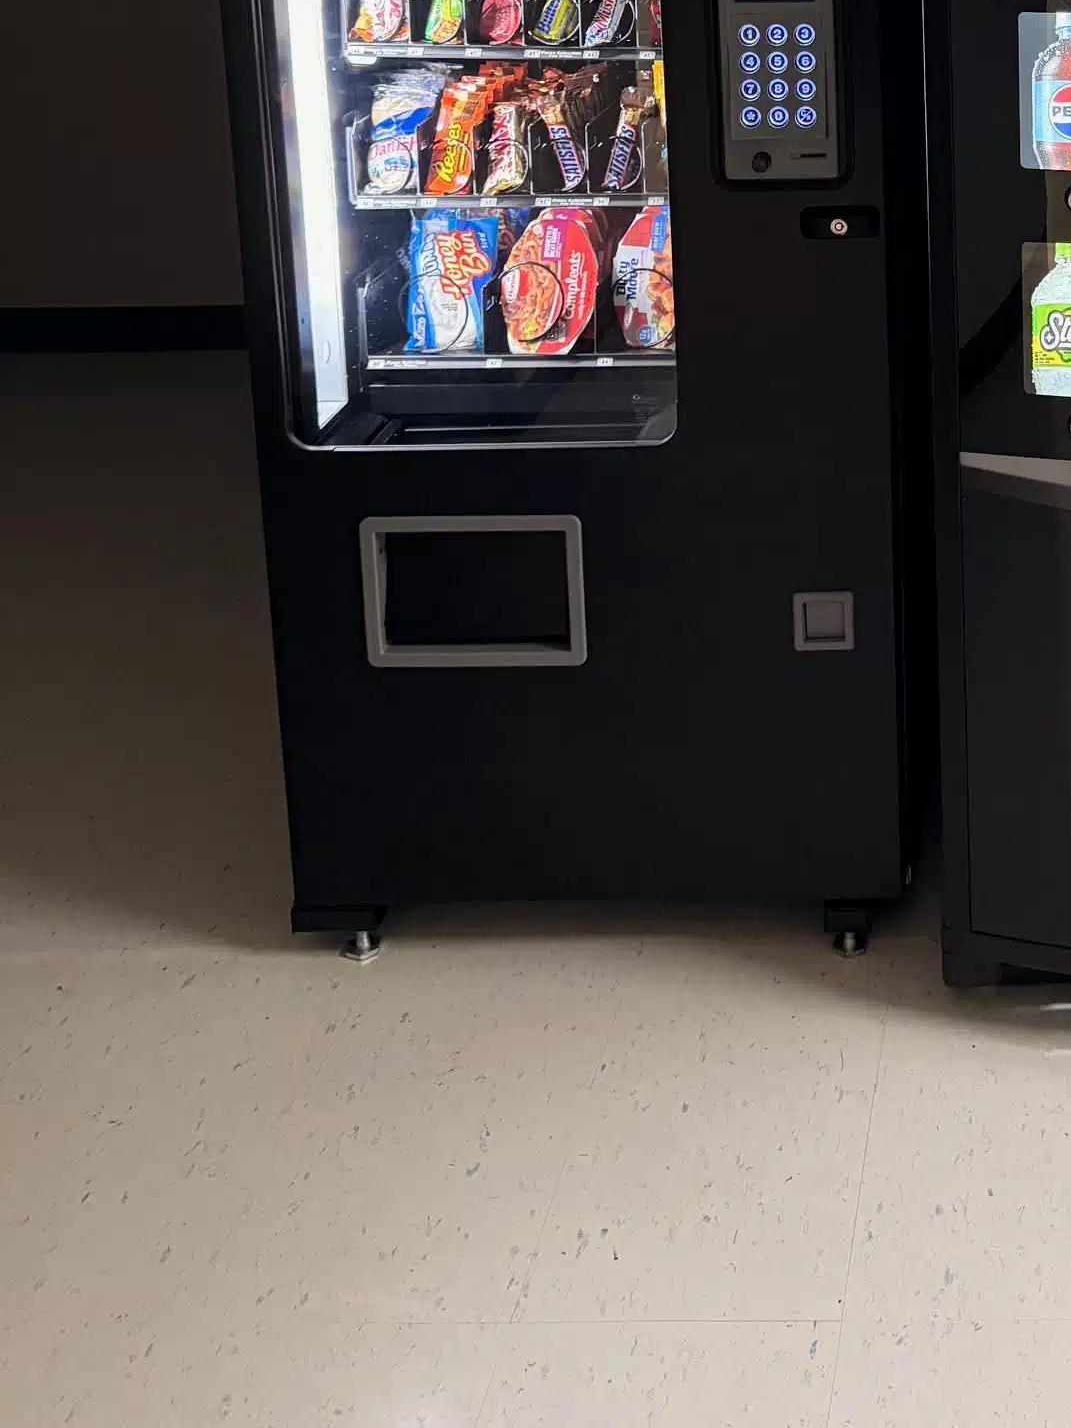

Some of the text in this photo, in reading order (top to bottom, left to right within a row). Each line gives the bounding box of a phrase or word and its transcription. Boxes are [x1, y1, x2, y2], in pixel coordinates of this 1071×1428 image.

[746, 29, 753, 39] 1
[773, 29, 782, 39] 2
[801, 28, 809, 38] 3
[746, 56, 754, 66] 4
[773, 56, 782, 66] 5
[801, 56, 810, 65] 6
[746, 84, 754, 93] 7
[774, 84, 783, 93] 8
[802, 83, 810, 93] 9
[775, 111, 783, 121] 0
[607, 125, 634, 188] SATISFIS
[458, 231, 490, 276] Bun
[437, 233, 470, 299] Honey
[564, 252, 582, 319] Compleats
